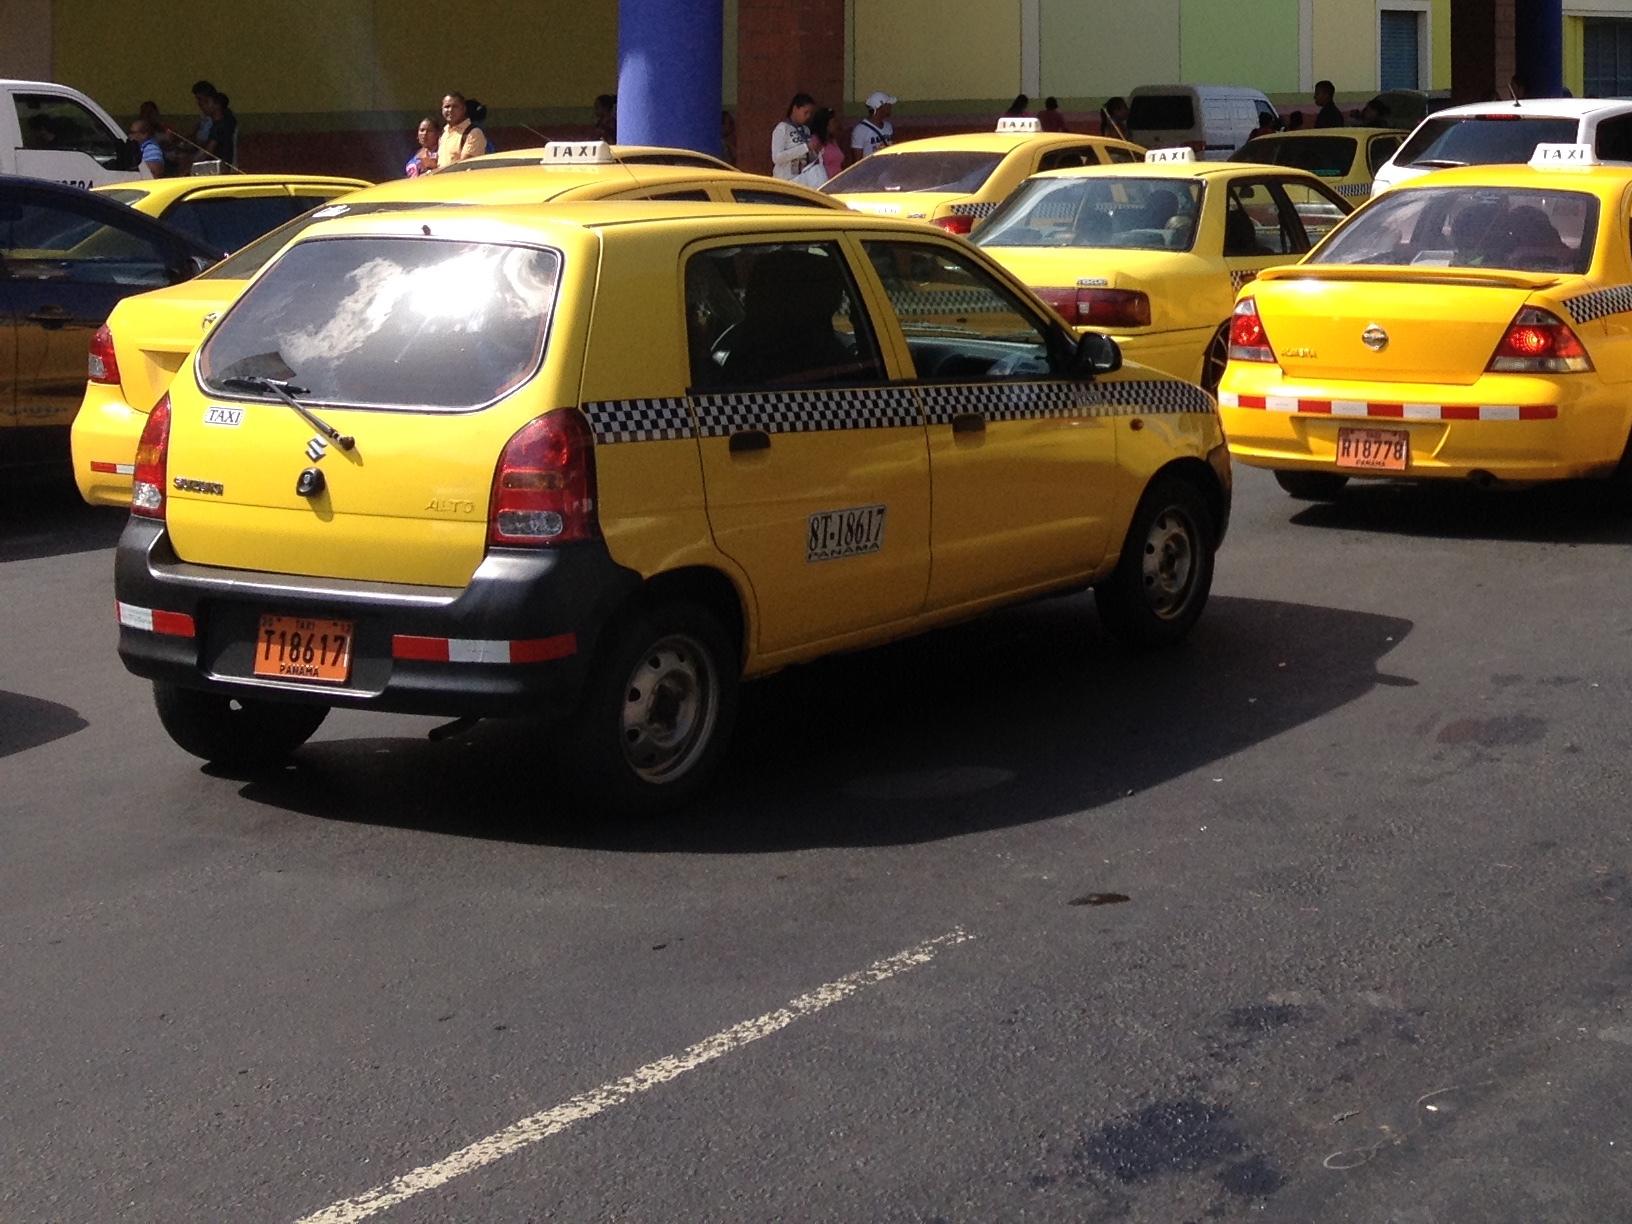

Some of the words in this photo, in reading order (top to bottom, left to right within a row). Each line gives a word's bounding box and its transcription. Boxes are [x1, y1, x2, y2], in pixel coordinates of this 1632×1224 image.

[1002, 121, 1033, 129] TAXI
[553, 145, 597, 158] TAXI
[1150, 151, 1186, 163] TAXI
[1542, 149, 1584, 160] TAXI
[208, 409, 242, 424] TAXI
[173, 477, 224, 496] SUZUKI
[424, 498, 475, 514] ALTO
[810, 508, 885, 552] 8T-18617
[808, 542, 880, 560] PANAMA
[264, 629, 345, 667] T18617
[279, 664, 320, 678] PANAMA
